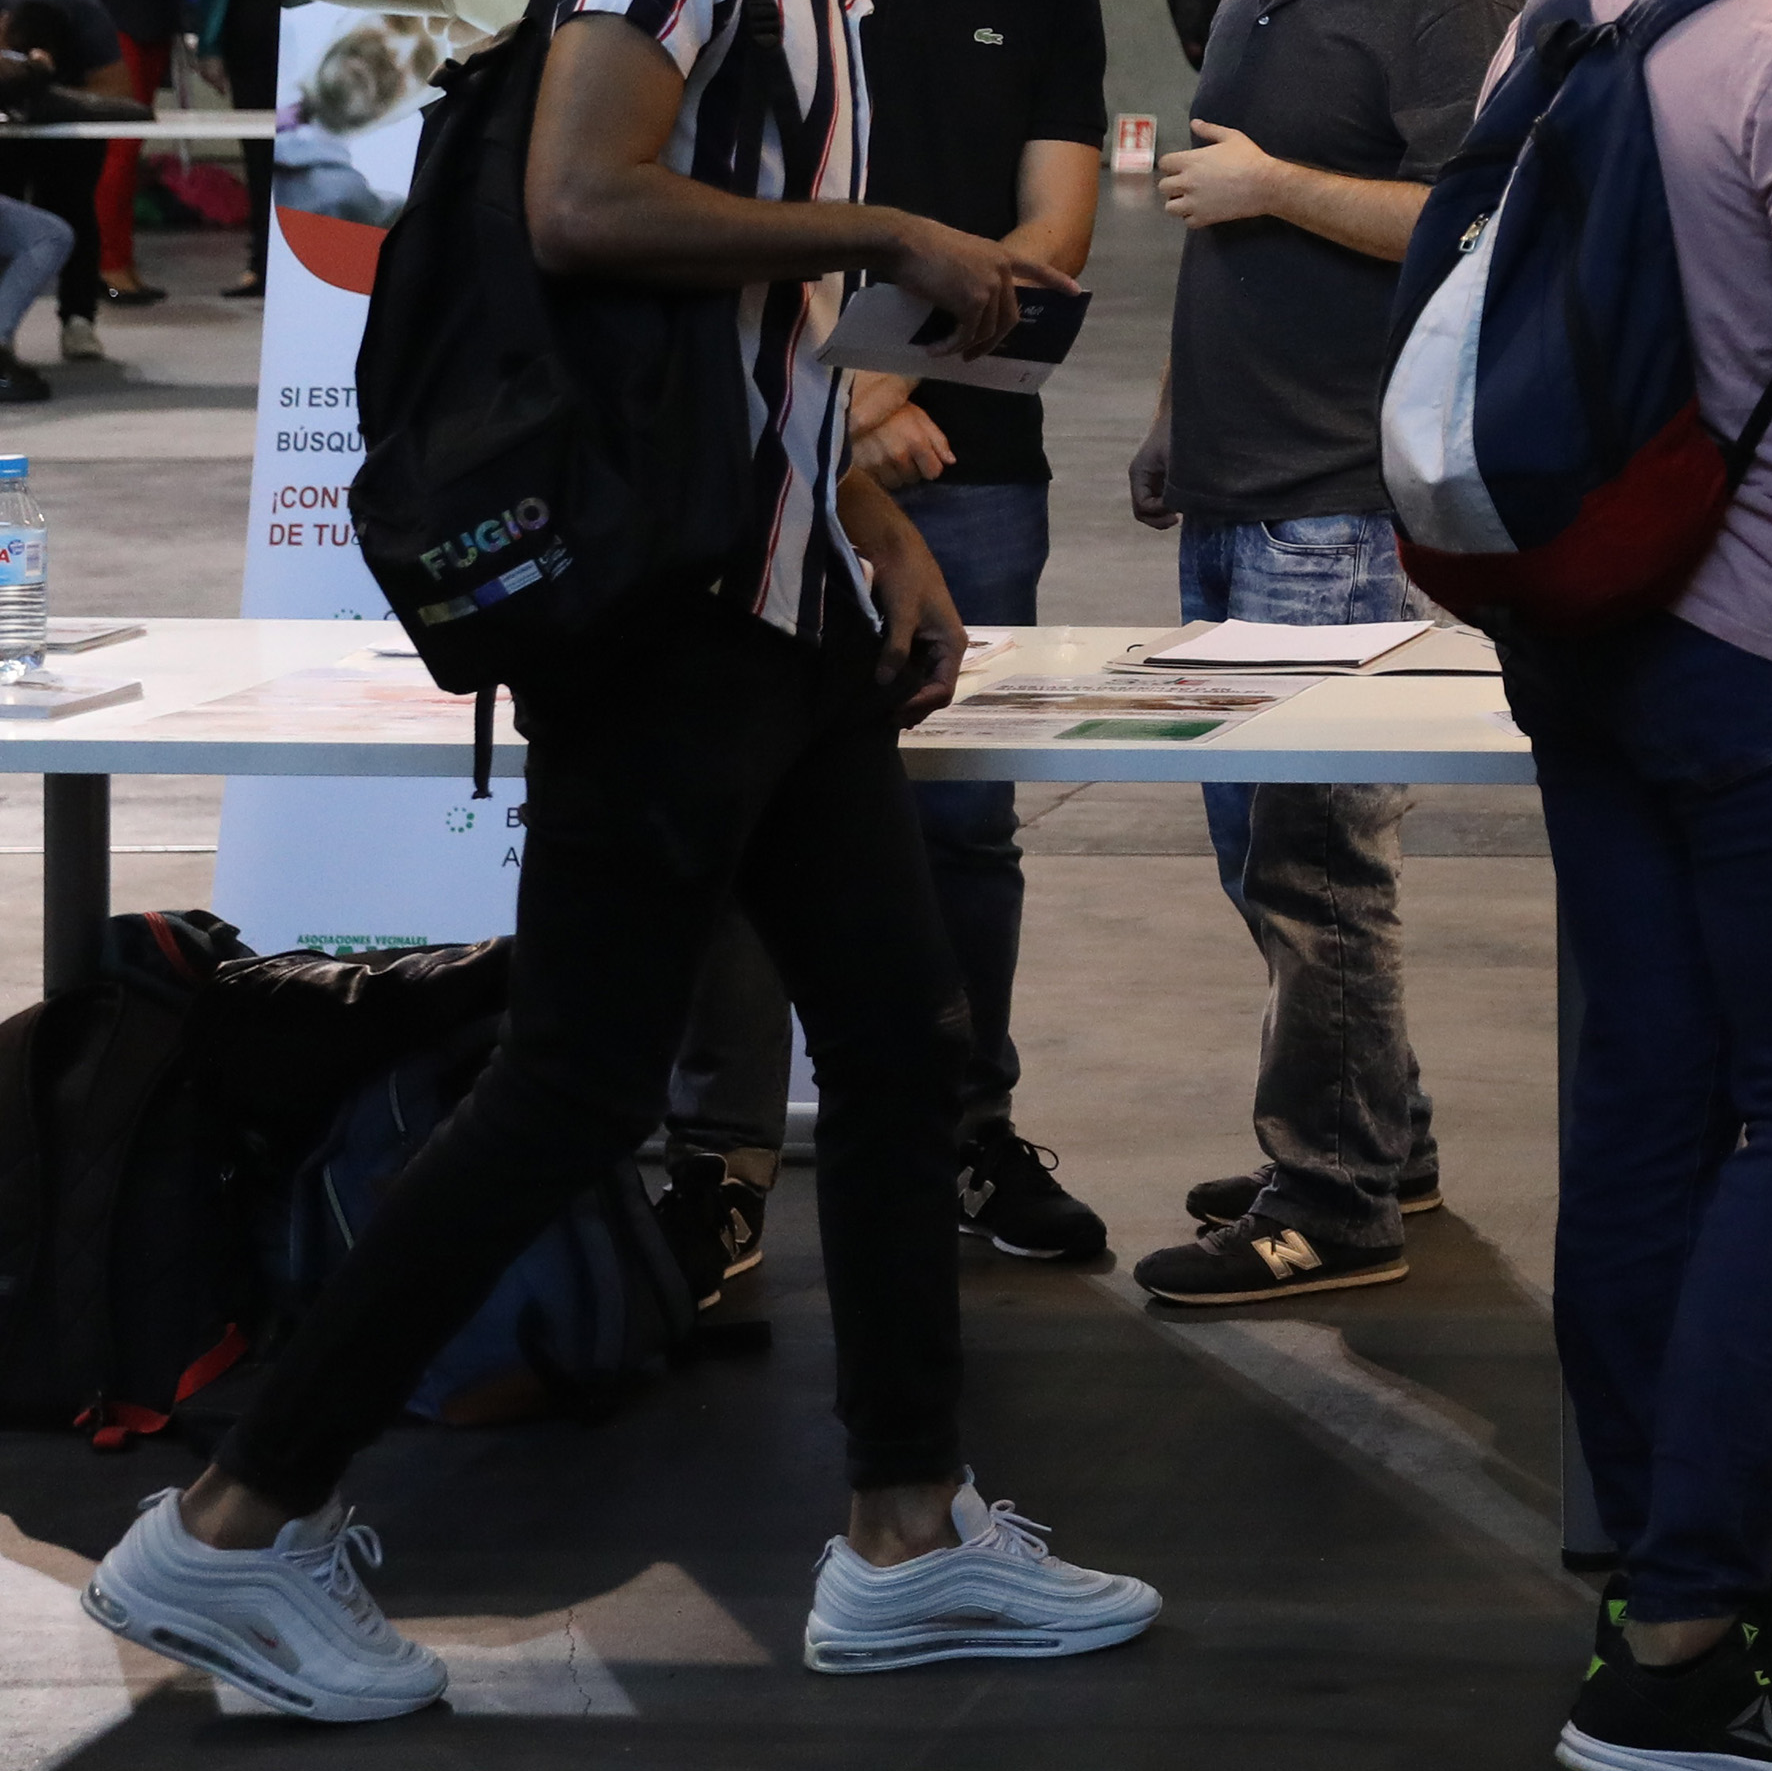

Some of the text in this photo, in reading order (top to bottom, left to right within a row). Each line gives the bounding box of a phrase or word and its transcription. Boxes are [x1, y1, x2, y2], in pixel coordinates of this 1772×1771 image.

[280, 387, 357, 408] SI EST
[276, 426, 363, 453] BÚSQU
[269, 523, 350, 547] DE TU
[419, 496, 550, 581] FUGIO
[502, 846, 520, 868] A
[297, 934, 428, 947] ASOCIACIONES VECINALES
